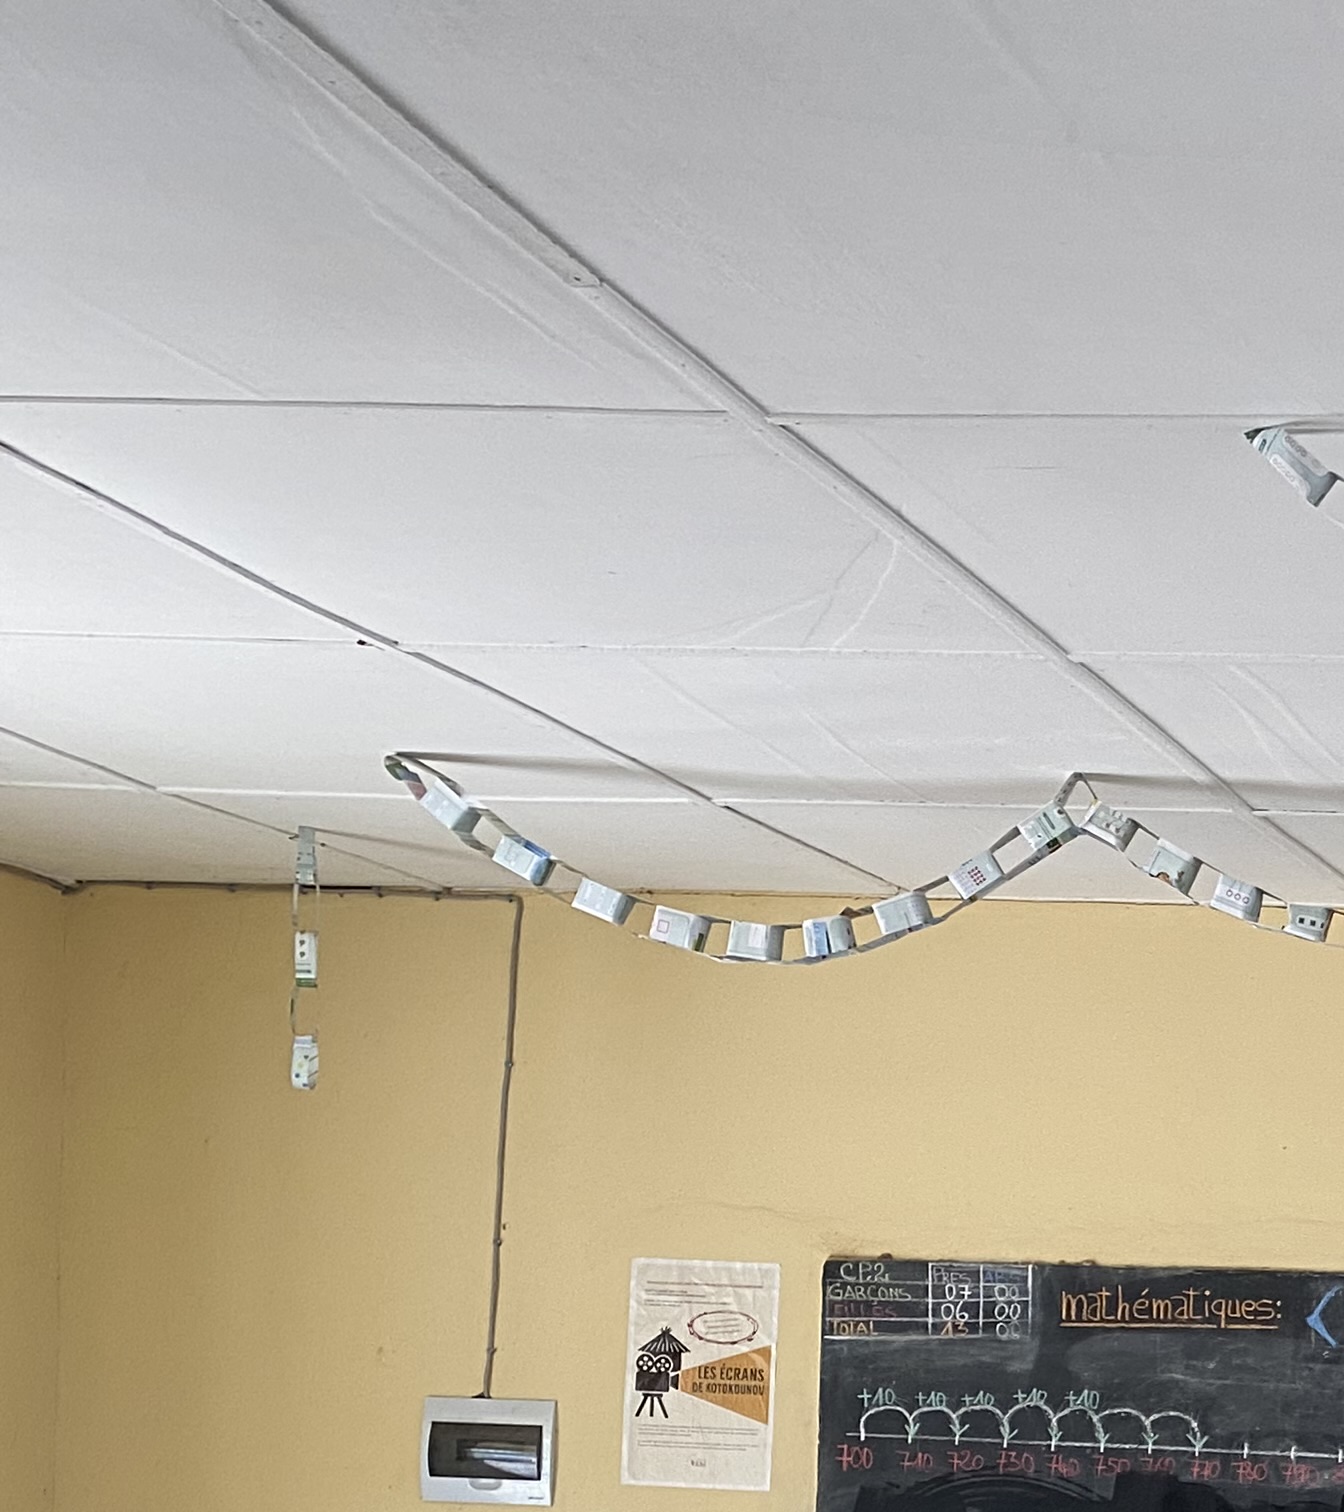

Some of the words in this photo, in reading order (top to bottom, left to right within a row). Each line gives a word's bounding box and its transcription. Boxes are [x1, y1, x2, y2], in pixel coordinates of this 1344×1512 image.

[945, 1284, 972, 1300] 07
[994, 1285, 1020, 1300] 00
[940, 1301, 969, 1321] 06
[994, 1303, 1021, 1321] 00
[1061, 1285, 1281, 1329] mathématiques:
[831, 1320, 879, 1335] TOTAL
[940, 1321, 969, 1336] 13
[698, 1366, 717, 1380] LES
[720, 1363, 765, 1382] ÉCRANS
[692, 1382, 703, 1393] DE
[836, 1444, 873, 1471] 700
[900, 1452, 933, 1472] 710
[948, 1451, 984, 1471] 720
[998, 1452, 1034, 1473] 730
